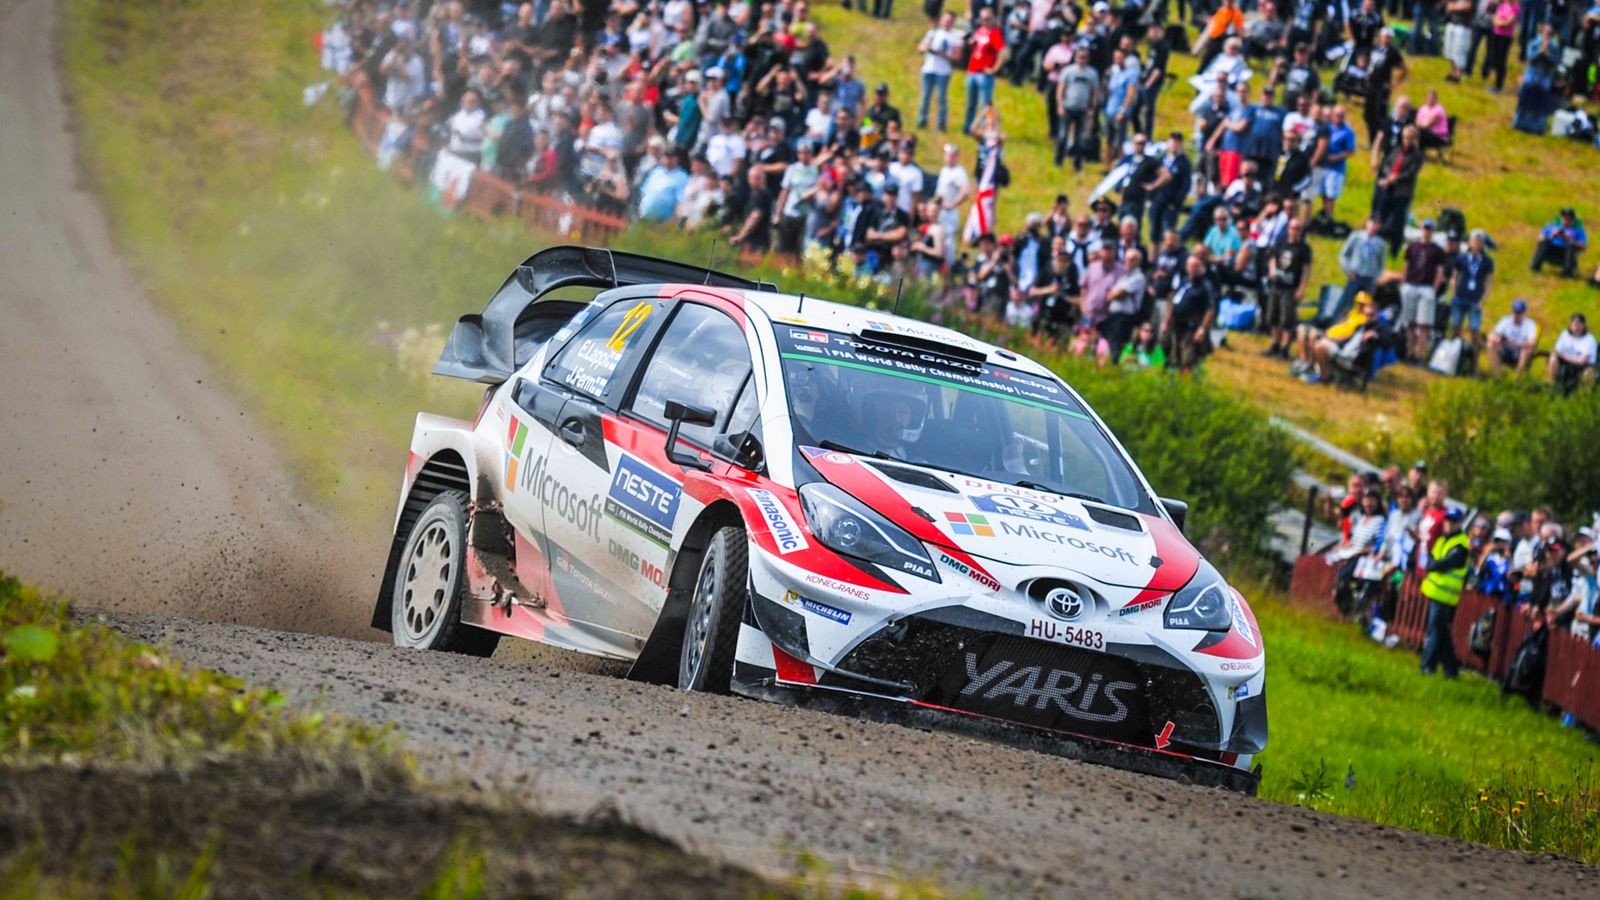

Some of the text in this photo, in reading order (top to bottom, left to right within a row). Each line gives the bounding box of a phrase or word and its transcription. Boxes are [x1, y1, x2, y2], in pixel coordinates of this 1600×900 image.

[606, 301, 653, 352] 12
[832, 349, 854, 360] FIA
[855, 353, 892, 366] World
[895, 361, 927, 374] Rally
[929, 367, 1015, 393] Championship
[833, 337, 916, 358] TOYOTA
[919, 353, 990, 375] GAZOO
[993, 370, 1059, 394] Racing
[521, 447, 603, 543] Microsoft
[965, 480, 1058, 503] DENSO
[1005, 497, 1045, 513] 12
[749, 488, 797, 550] Panasonic
[607, 538, 639, 572] DMG
[1000, 521, 1140, 567] Microsoft
[903, 561, 933, 577] PIAA
[939, 554, 1002, 593] DMG MORI
[805, 574, 871, 601] KONECRANES
[804, 600, 851, 622] MICHELIN
[1119, 598, 1162, 617] DMG MORI
[1169, 617, 1190, 626] PIAA
[1031, 618, 1104, 650] HU-5483
